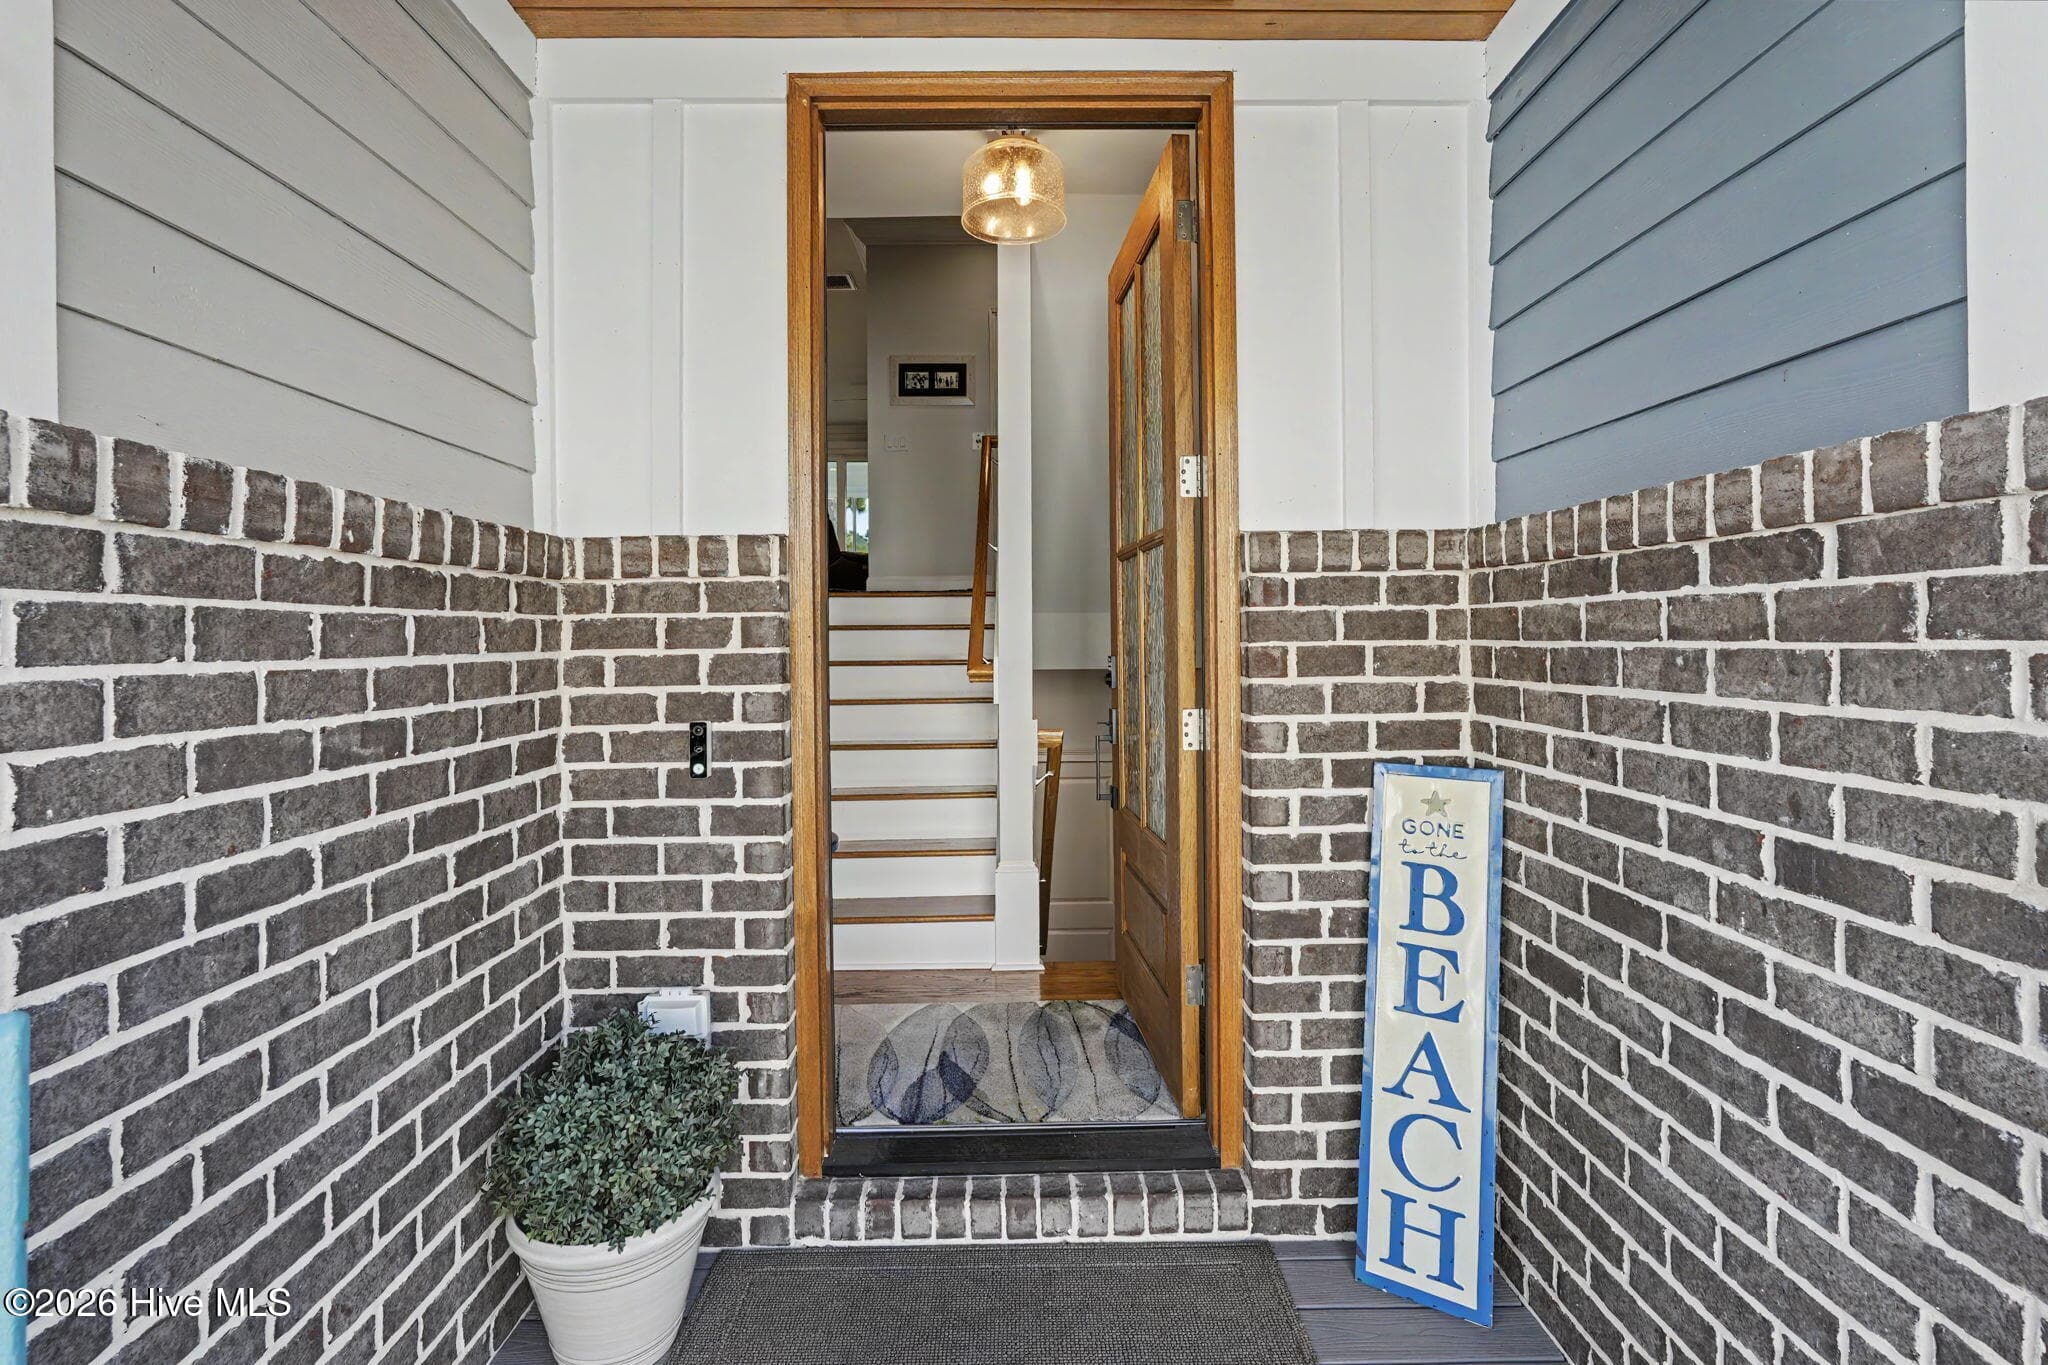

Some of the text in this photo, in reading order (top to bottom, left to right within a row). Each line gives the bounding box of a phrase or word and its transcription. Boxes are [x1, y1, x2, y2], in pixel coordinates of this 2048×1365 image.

[1401, 819, 1464, 840] GONE
[1397, 838, 1467, 860] to the
[1379, 861, 1471, 1291] BEACH
